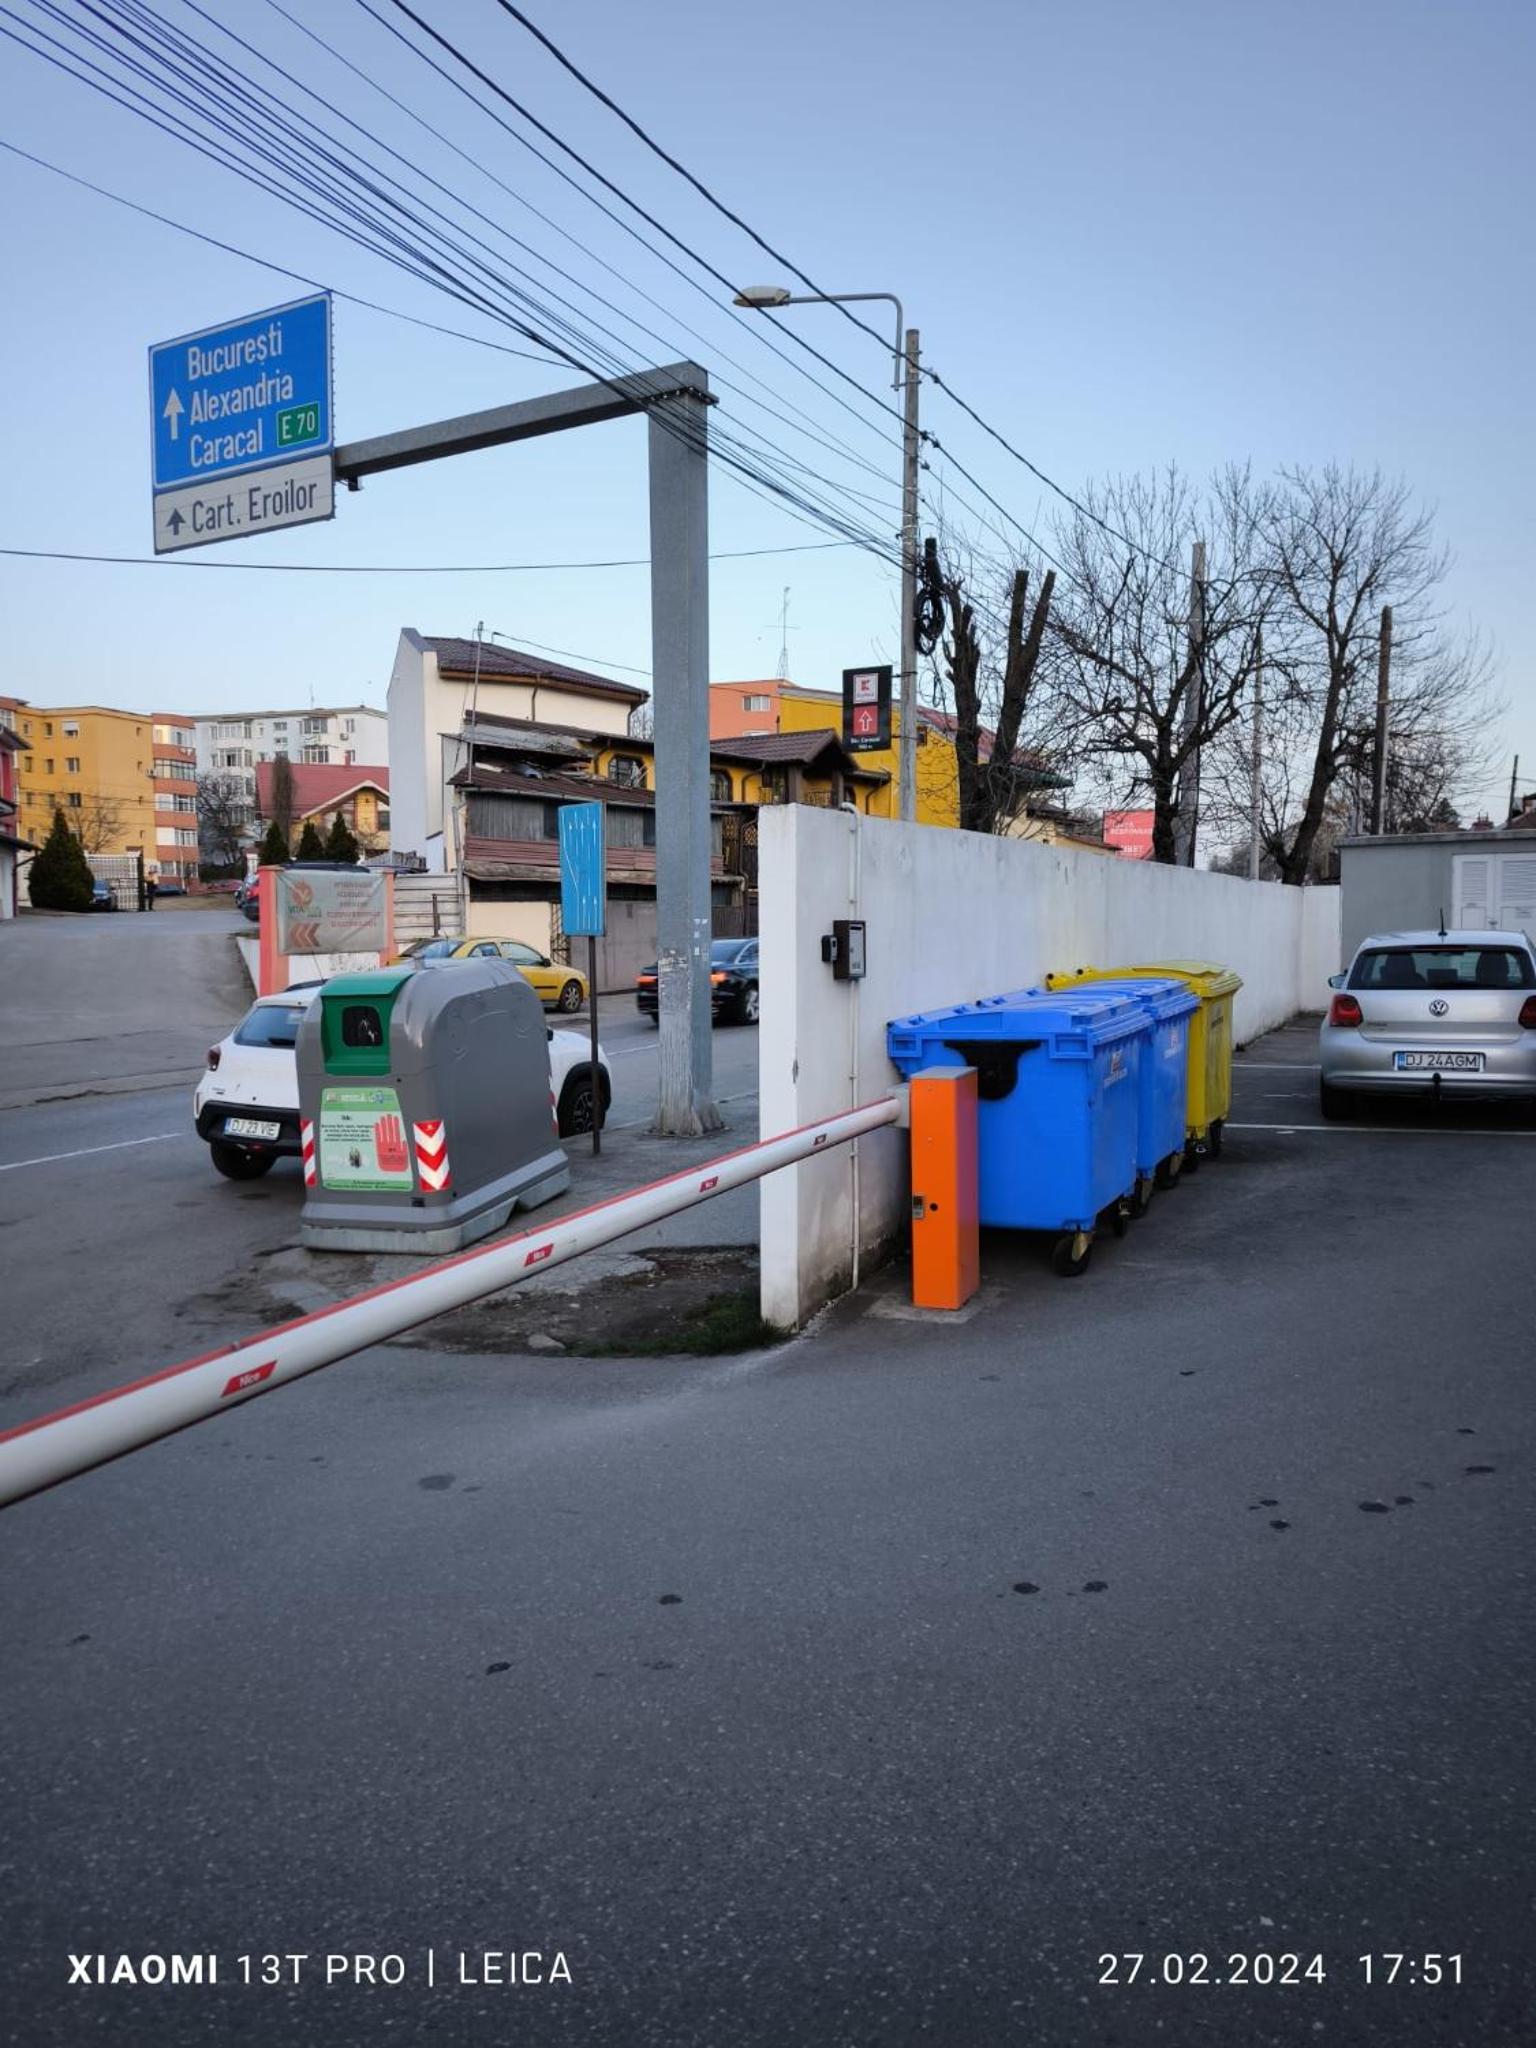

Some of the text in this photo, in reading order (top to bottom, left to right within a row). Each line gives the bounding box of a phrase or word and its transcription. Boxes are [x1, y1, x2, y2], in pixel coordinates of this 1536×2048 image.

[187, 322, 283, 381] București
[190, 369, 293, 426] Alexandria
[190, 417, 263, 467] Caracal
[281, 410, 316, 440] E 70
[192, 478, 317, 533] Cart. Eroilor
[1406, 1054, 1423, 1066] DJ
